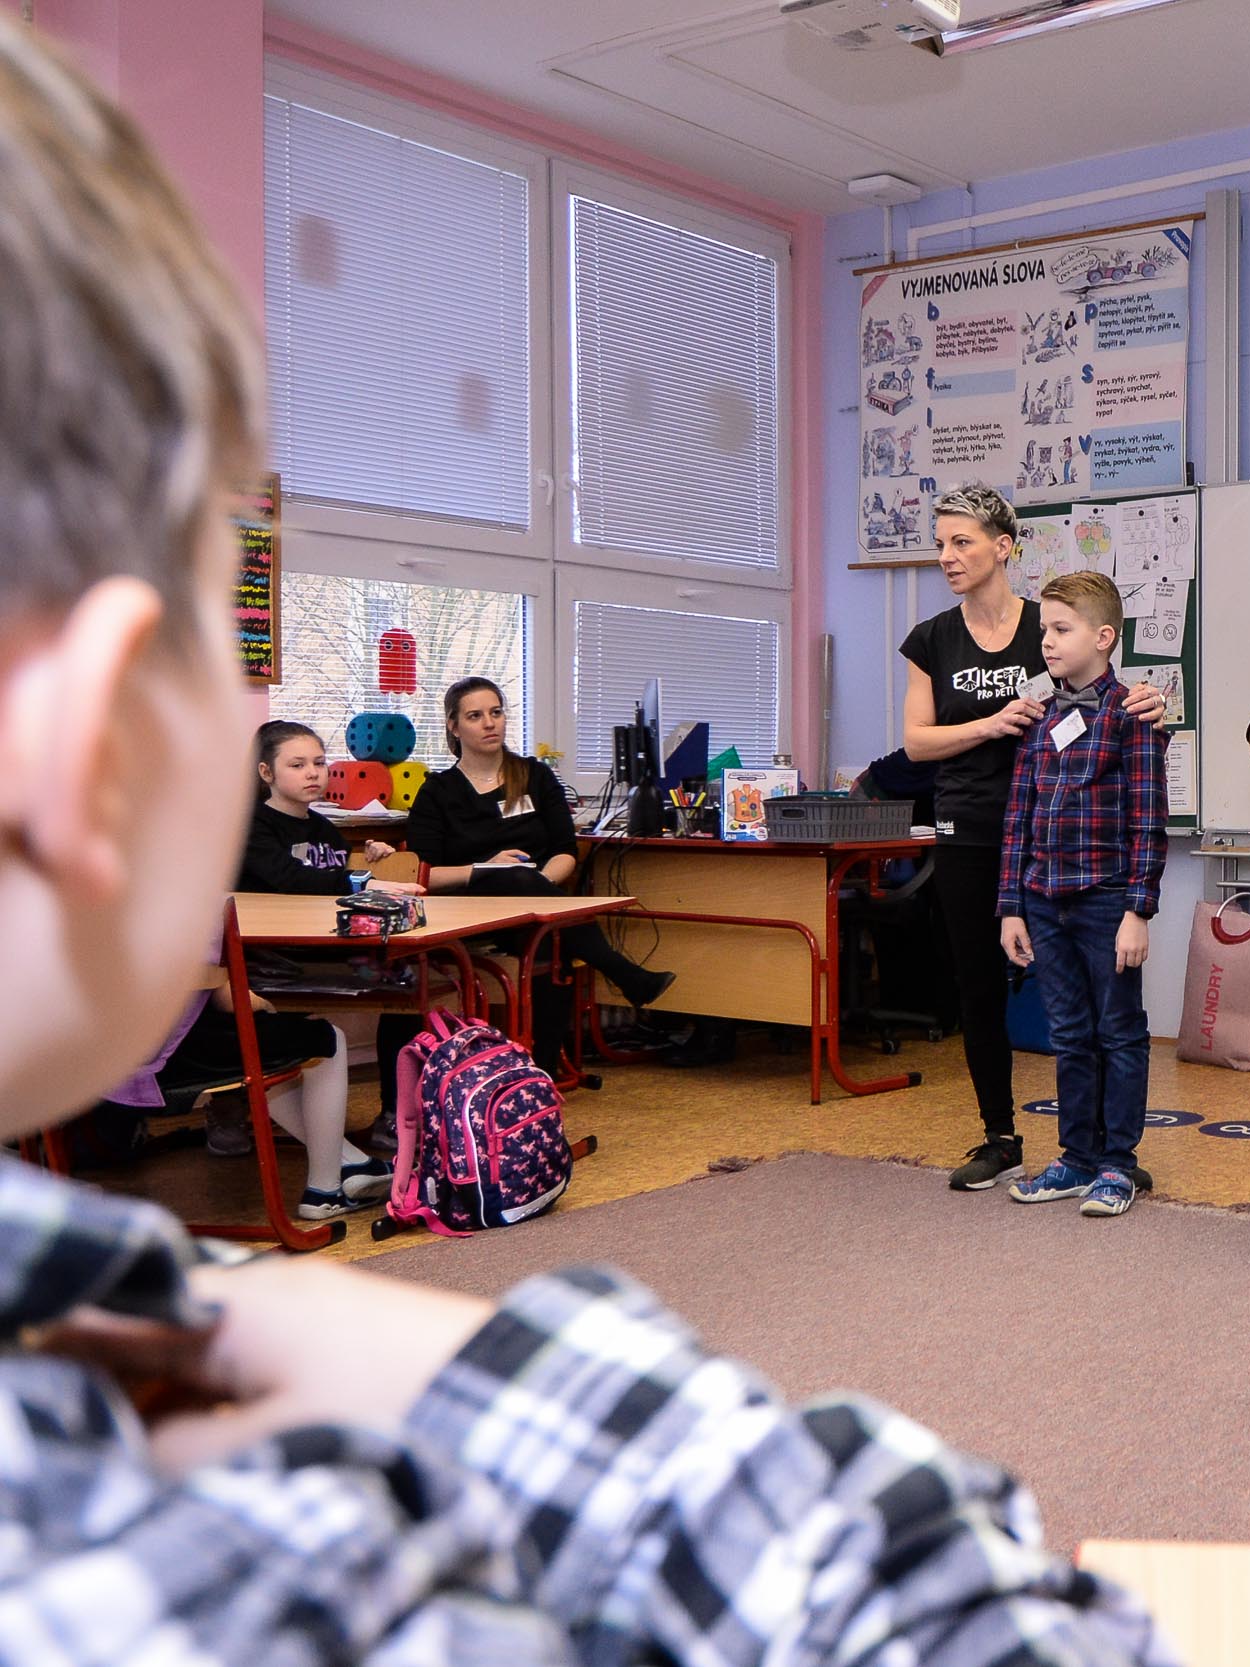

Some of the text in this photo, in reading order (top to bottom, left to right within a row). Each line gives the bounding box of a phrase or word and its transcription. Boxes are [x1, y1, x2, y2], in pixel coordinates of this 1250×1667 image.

[901, 258, 1046, 299] VYJMENOVANÁ SLOVA
[928, 301, 940, 321] b
[1084, 303, 1099, 325] p
[952, 665, 1029, 691] ETIKETA
[977, 688, 994, 701] PRO
[1200, 963, 1224, 1052] LAUNDRY
